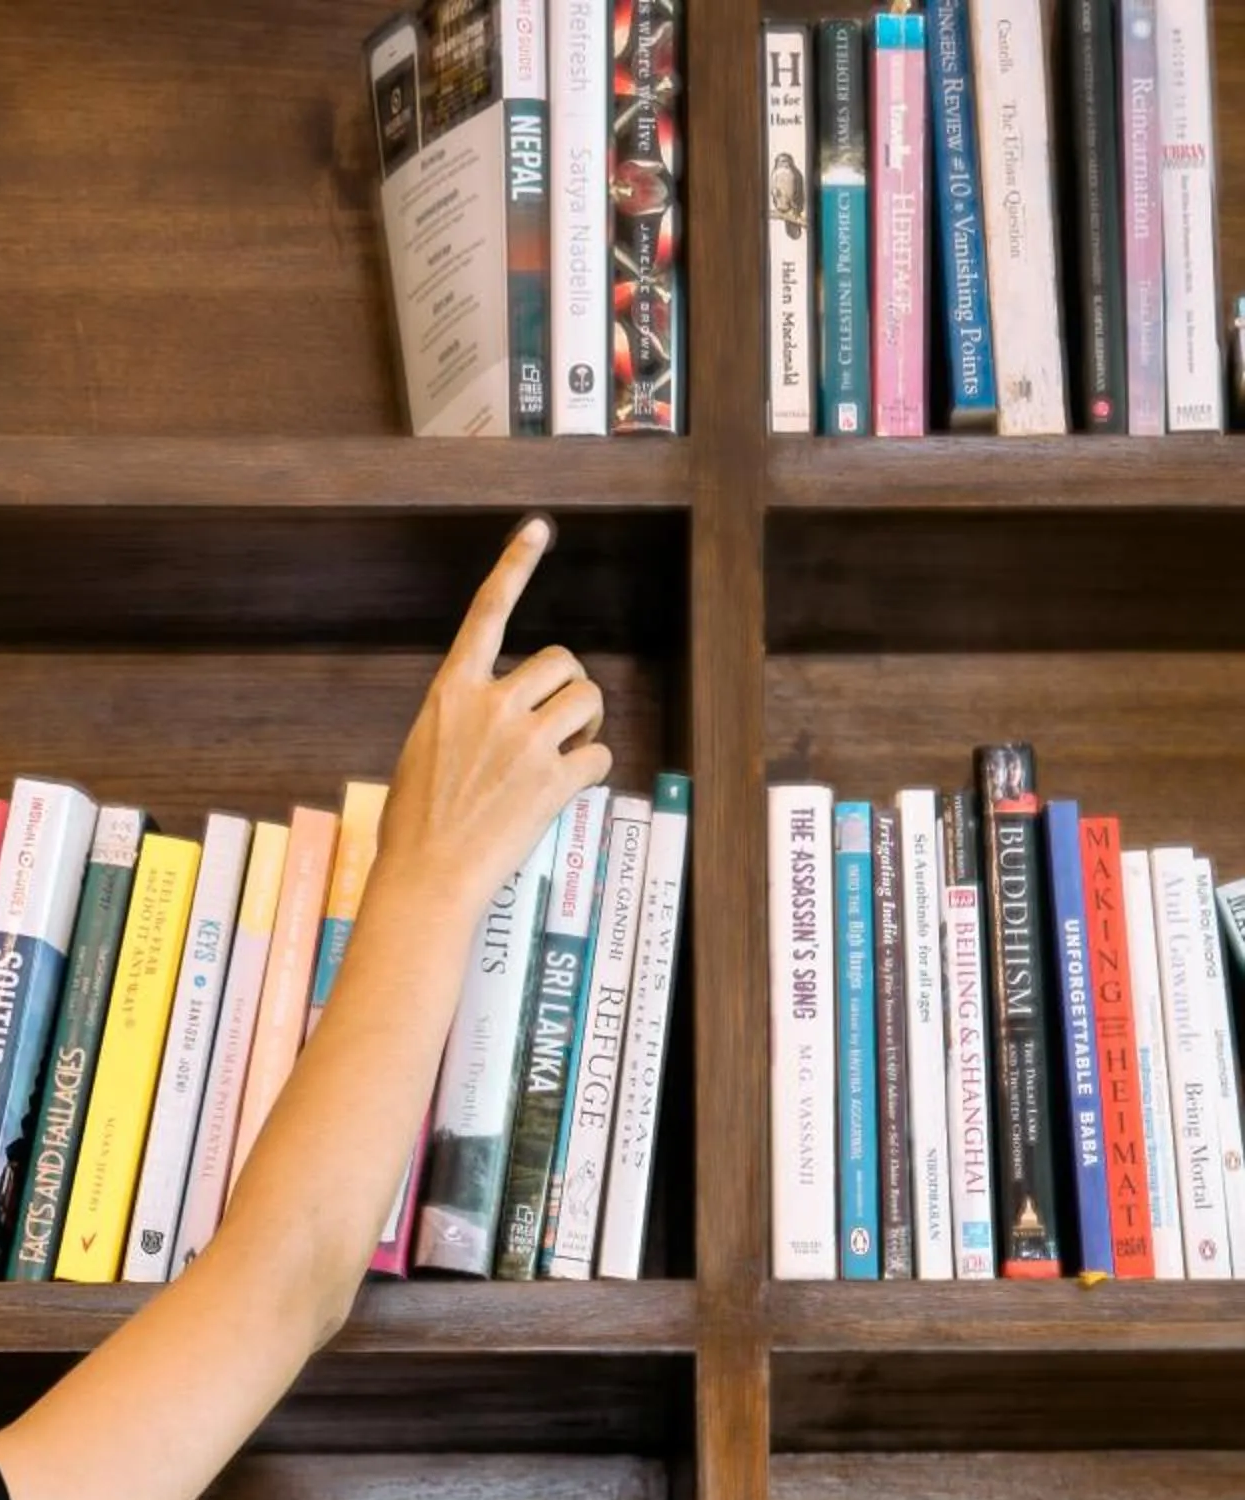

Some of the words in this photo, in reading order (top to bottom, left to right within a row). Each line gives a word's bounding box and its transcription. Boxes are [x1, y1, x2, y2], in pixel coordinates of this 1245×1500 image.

[569, 3, 592, 92] Refresh
[636, 18, 655, 78] where
[771, 52, 801, 87] H
[835, 29, 850, 101] REDFIELD
[997, 19, 1013, 74] Castells
[637, 85, 653, 111] we
[770, 112, 802, 127] Hawk
[784, 94, 800, 106] for
[943, 78, 964, 152] REVIEW
[1002, 101, 1018, 130] The
[510, 115, 543, 201] NEPAL
[637, 117, 655, 151] live
[836, 107, 850, 155] JAMES
[1004, 136, 1021, 185] Urban
[1130, 77, 1154, 240] Reincarnation
[566, 147, 594, 214] Satya
[949, 157, 972, 196] #10
[836, 191, 852, 272] PROPHECY
[892, 191, 915, 315] HERITAGE
[1006, 190, 1025, 258] Question
[569, 225, 594, 317] Nadella
[640, 224, 652, 294] JANELLE
[782, 261, 798, 304] Helen
[954, 216, 979, 321] Vanishing
[640, 303, 652, 360] BROWN
[781, 312, 799, 386] Macdonald
[837, 281, 852, 364] CELESTINE
[960, 327, 983, 395] Points
[572, 799, 591, 851] INSIGHT
[618, 823, 641, 888] GOPAL
[790, 807, 815, 843] THE
[874, 816, 896, 897] Irrigating
[913, 834, 927, 854] Sri
[561, 873, 582, 918] GUIDES
[608, 888, 634, 962] GANDHI
[790, 850, 820, 962] ASSASSIN'S
[881, 900, 898, 945] India
[914, 858, 931, 938] Aurobindo
[999, 825, 1034, 1016] BUDDHISM
[1161, 873, 1187, 925] Atul
[192, 918, 222, 968] KEYS
[653, 879, 678, 994] LEWIS
[918, 945, 932, 967] for
[543, 950, 578, 997] SRI
[791, 966, 818, 1021] SONG
[918, 970, 932, 987] all
[955, 920, 978, 1022] BEIJING
[1171, 934, 1201, 1053] Gawande
[918, 991, 932, 1024] ages
[960, 1026, 979, 1047] &
[527, 1001, 571, 1095] LANKA
[578, 983, 627, 1131] REFUGE
[797, 1043, 814, 1084] M.G.
[1064, 919, 1092, 1097] UNFORGETTABLE
[1079, 1111, 1098, 1167] BABA
[42, 1046, 86, 1149] FALLACIES
[632, 1012, 663, 1171] THOMAS
[1183, 1081, 1206, 1138] Being
[797, 1095, 815, 1188] VASSANJI
[961, 1053, 986, 1196] SHANGHAI
[34, 1151, 66, 1201] AND
[1190, 1144, 1213, 1210] Mortal
[18, 1202, 56, 1264] FACTS
